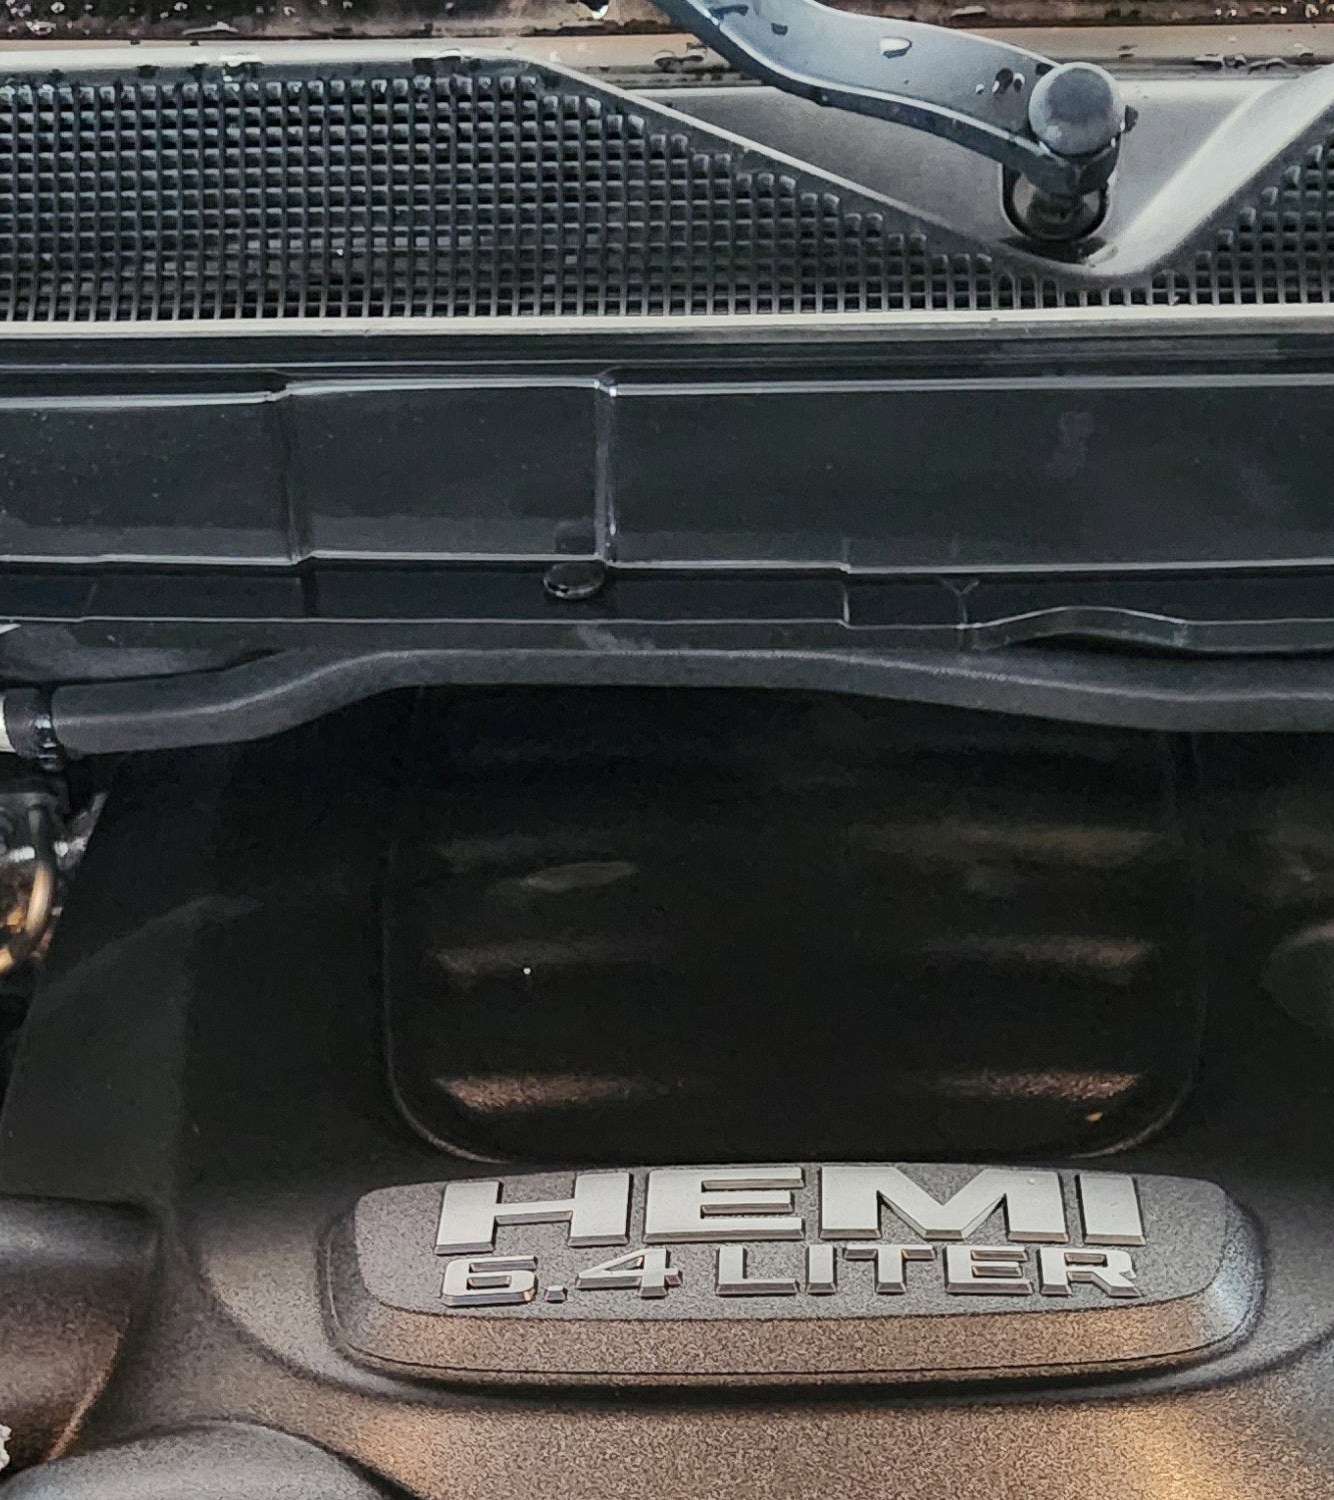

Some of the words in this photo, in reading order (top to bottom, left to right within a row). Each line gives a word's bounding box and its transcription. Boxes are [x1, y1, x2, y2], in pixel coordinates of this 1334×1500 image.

[435, 1167, 1147, 1252] HEMI
[442, 1248, 682, 1305] 6.4
[714, 1242, 1145, 1299] LITER
